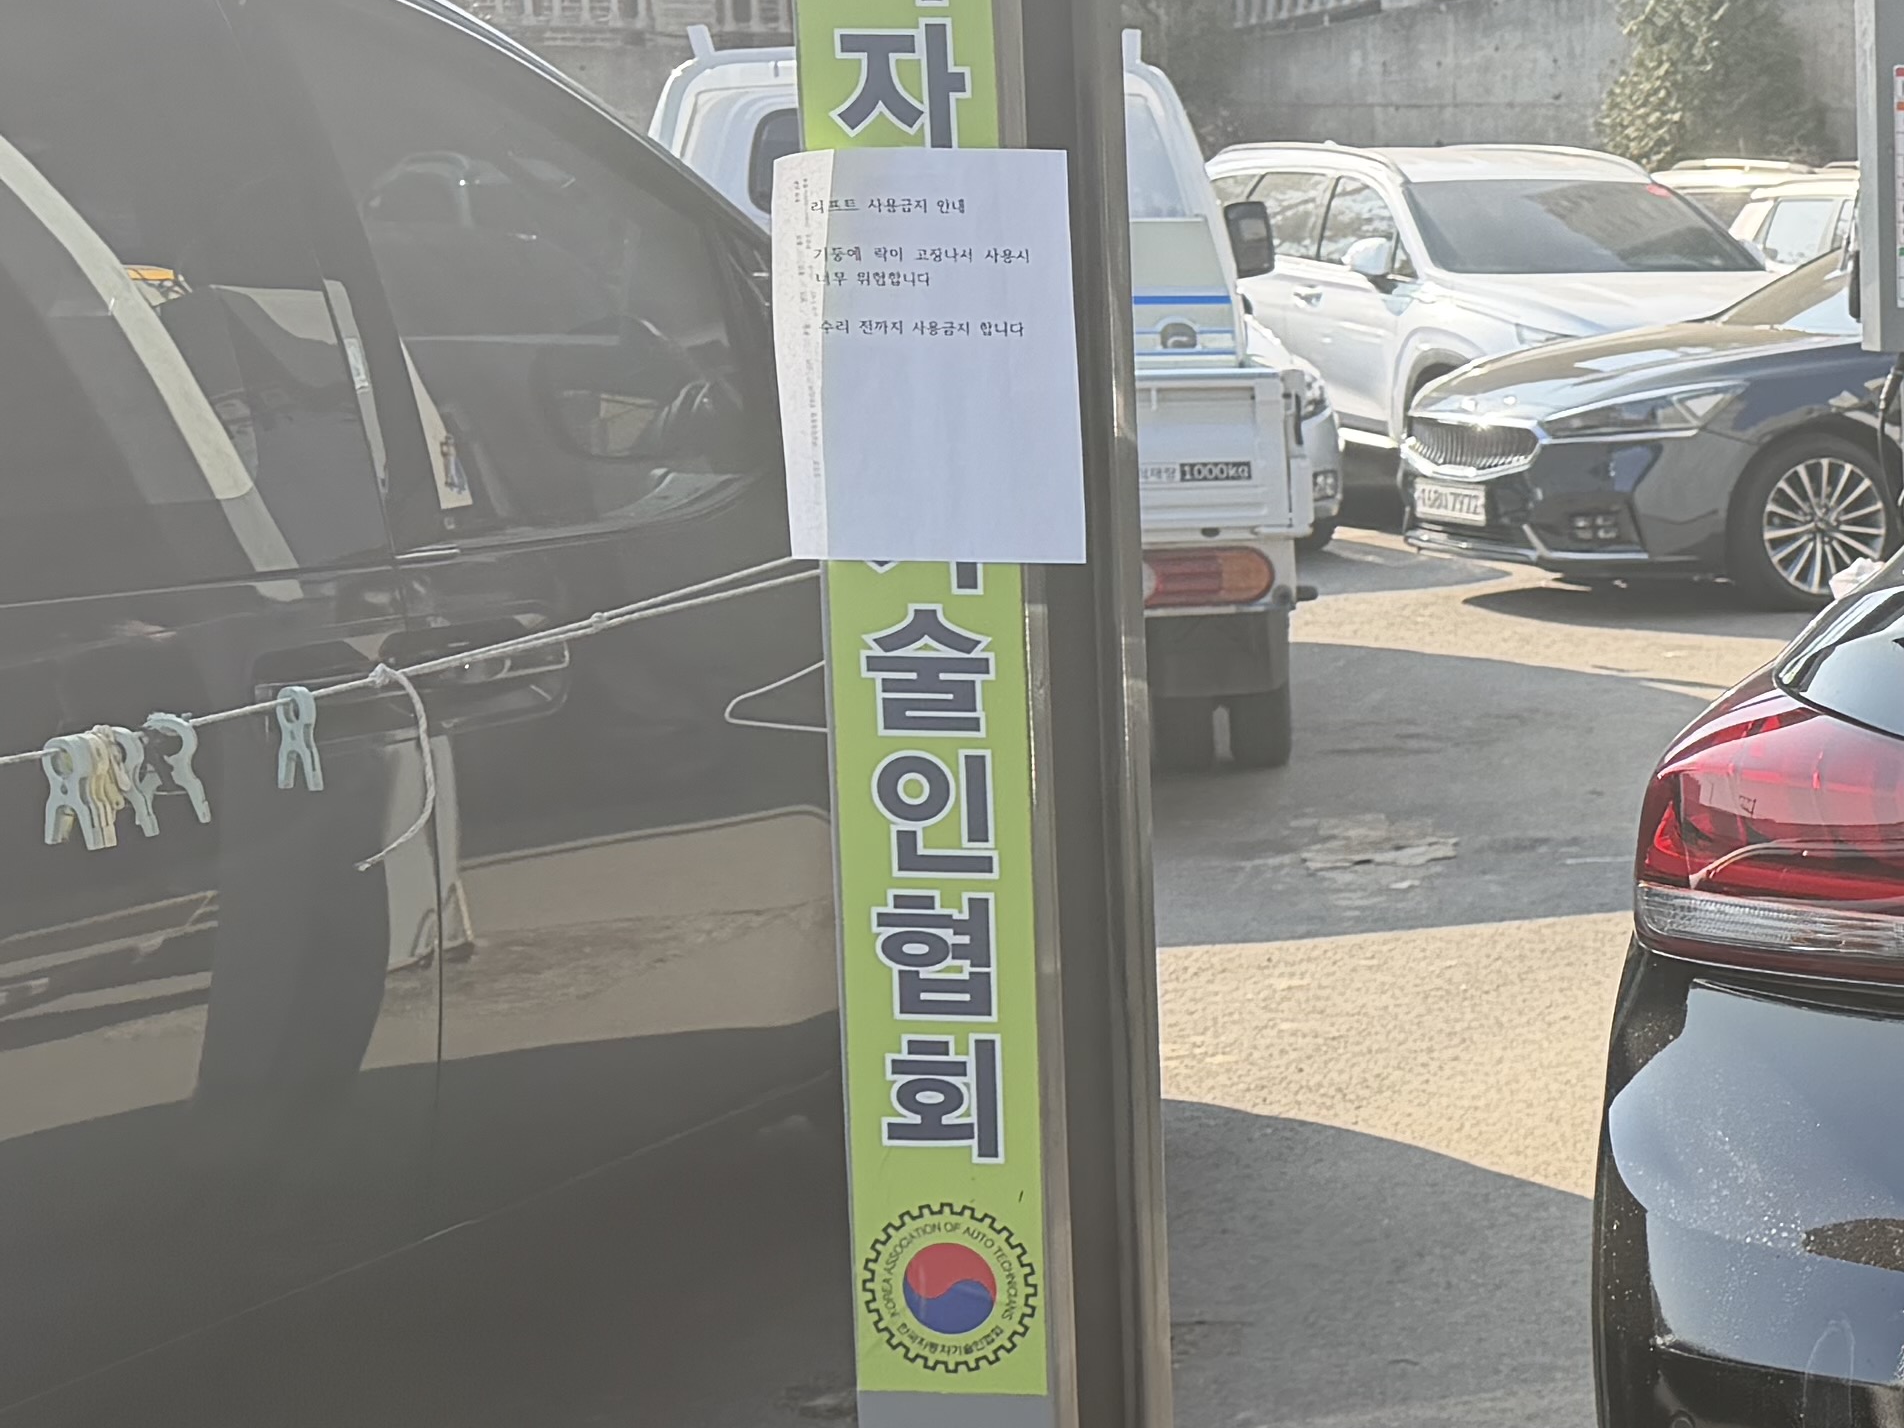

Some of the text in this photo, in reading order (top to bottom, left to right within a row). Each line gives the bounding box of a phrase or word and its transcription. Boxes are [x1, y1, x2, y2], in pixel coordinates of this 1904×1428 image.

[811, 198, 965, 214] 리프트 사용금지 안내
[874, 246, 903, 262] 락이
[915, 247, 973, 262] 고장나서
[985, 248, 1030, 264] 사용시
[815, 271, 930, 286] 너무 위험합니다
[820, 319, 1024, 337] 수리 전까지 사용금지 합니다
[1183, 463, 1249, 480] 1000kg
[944, 1222, 961, 1233] OF
[963, 1227, 994, 1249] AUTO
[885, 1222, 941, 1273] ASSOCIATION
[882, 1278, 898, 1318] KOREA
